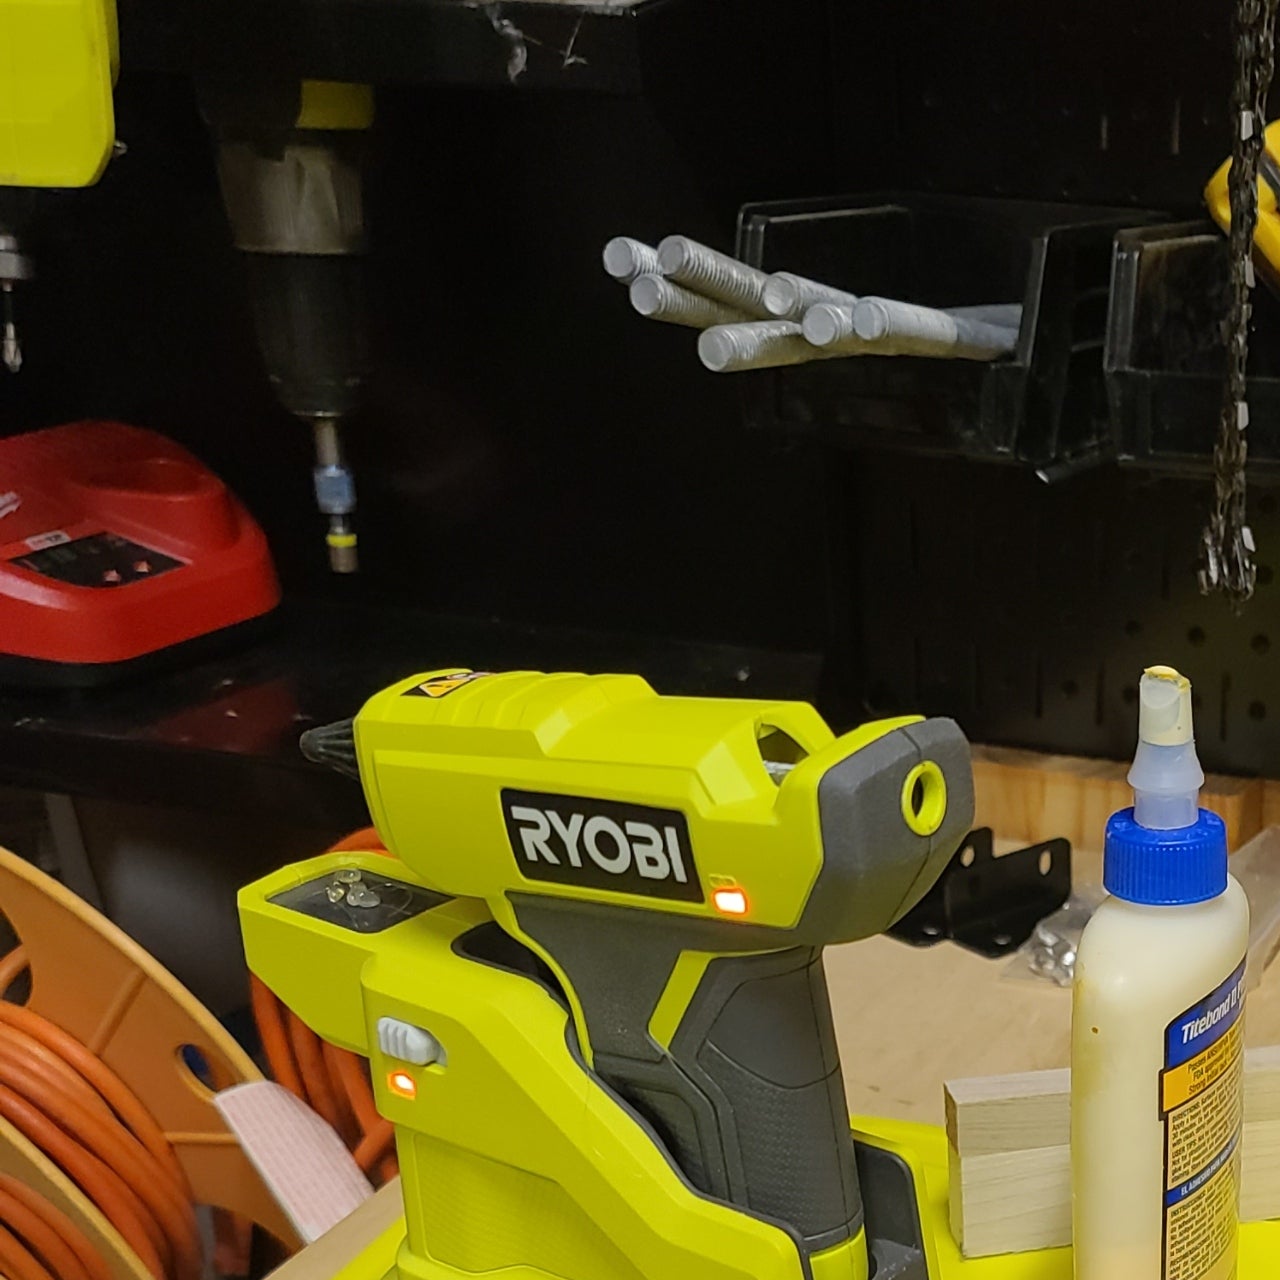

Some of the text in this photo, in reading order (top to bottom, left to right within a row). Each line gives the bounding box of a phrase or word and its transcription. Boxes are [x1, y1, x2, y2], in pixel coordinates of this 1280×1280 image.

[510, 805, 688, 883] RYOBI
[1181, 993, 1231, 1045] Titebond
[1181, 1184, 1188, 1197] EL
